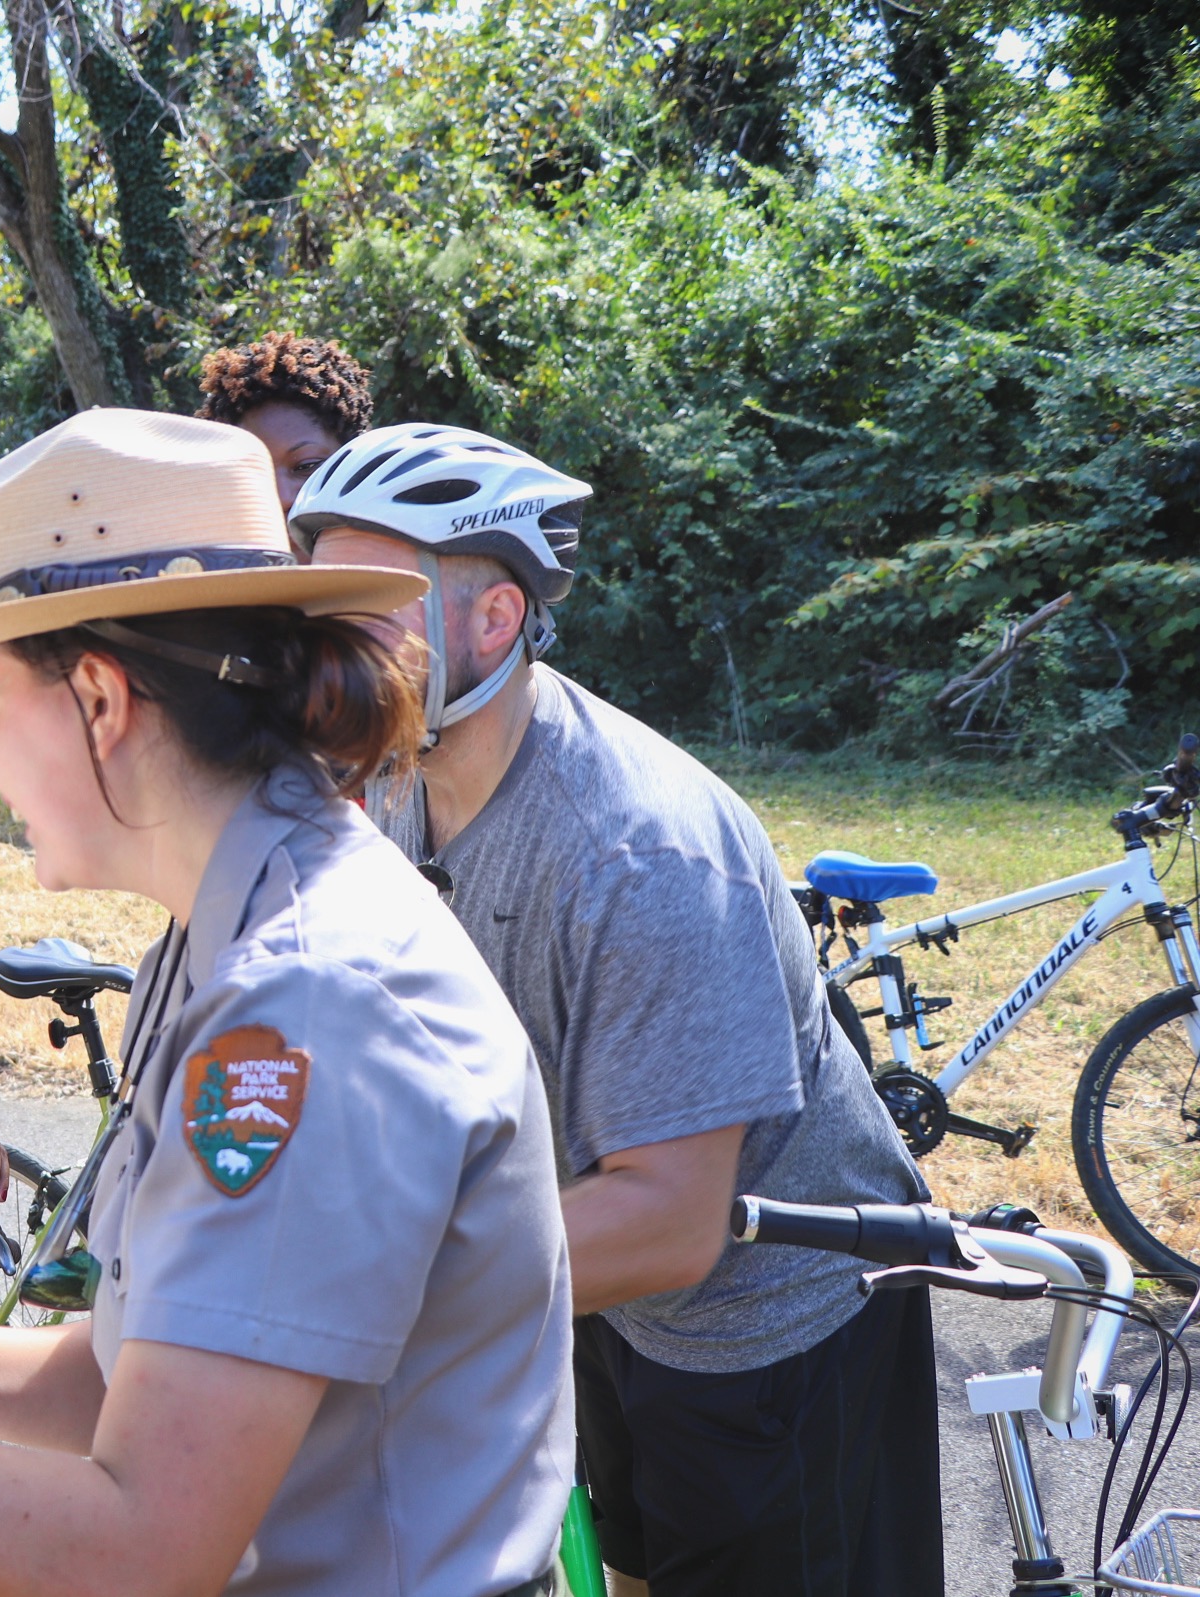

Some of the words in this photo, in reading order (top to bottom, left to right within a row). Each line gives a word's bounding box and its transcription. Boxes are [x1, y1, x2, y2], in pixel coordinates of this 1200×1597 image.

[447, 498, 544, 535] SPECIALIZED
[1121, 882, 1132, 895] 4
[226, 1059, 299, 1074] NATIONAL
[1093, 1042, 1123, 1091] Country
[240, 1072, 279, 1086] PARK
[230, 1085, 289, 1100] SERVICE
[1090, 1095, 1099, 1105] &
[1087, 1108, 1097, 1145] Town
